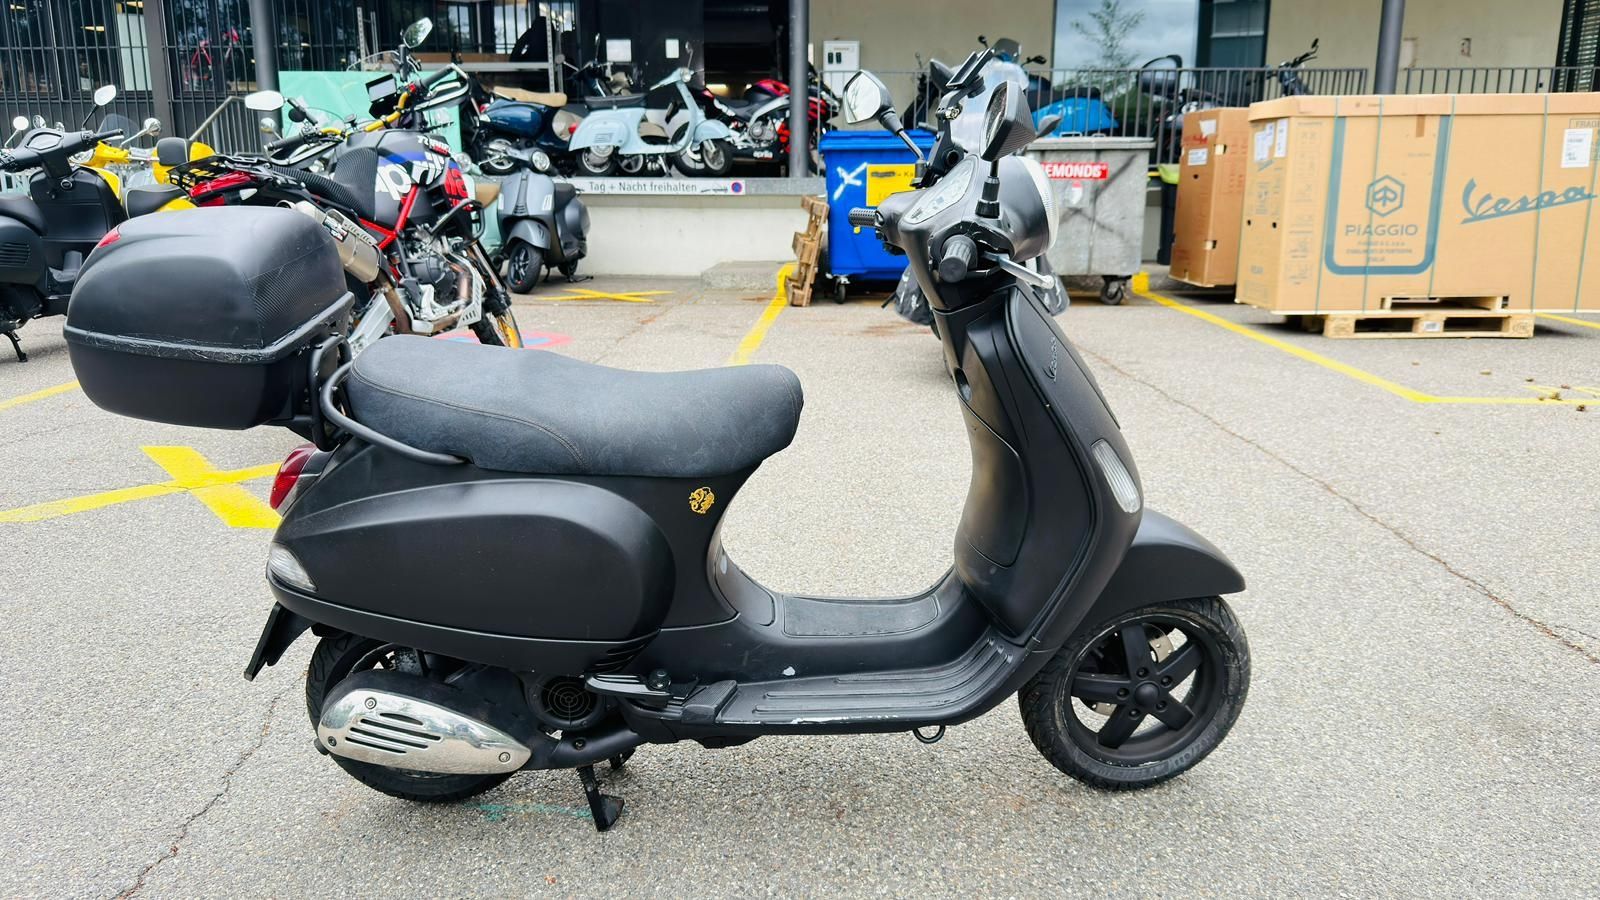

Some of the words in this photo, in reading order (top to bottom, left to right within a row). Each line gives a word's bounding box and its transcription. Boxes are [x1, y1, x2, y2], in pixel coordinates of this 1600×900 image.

[589, 181, 606, 193] Tag
[619, 181, 647, 192] Nacht
[650, 181, 697, 192] freihalten
[1460, 177, 1598, 224] Vespa
[1345, 223, 1418, 236] PIAGGIO
